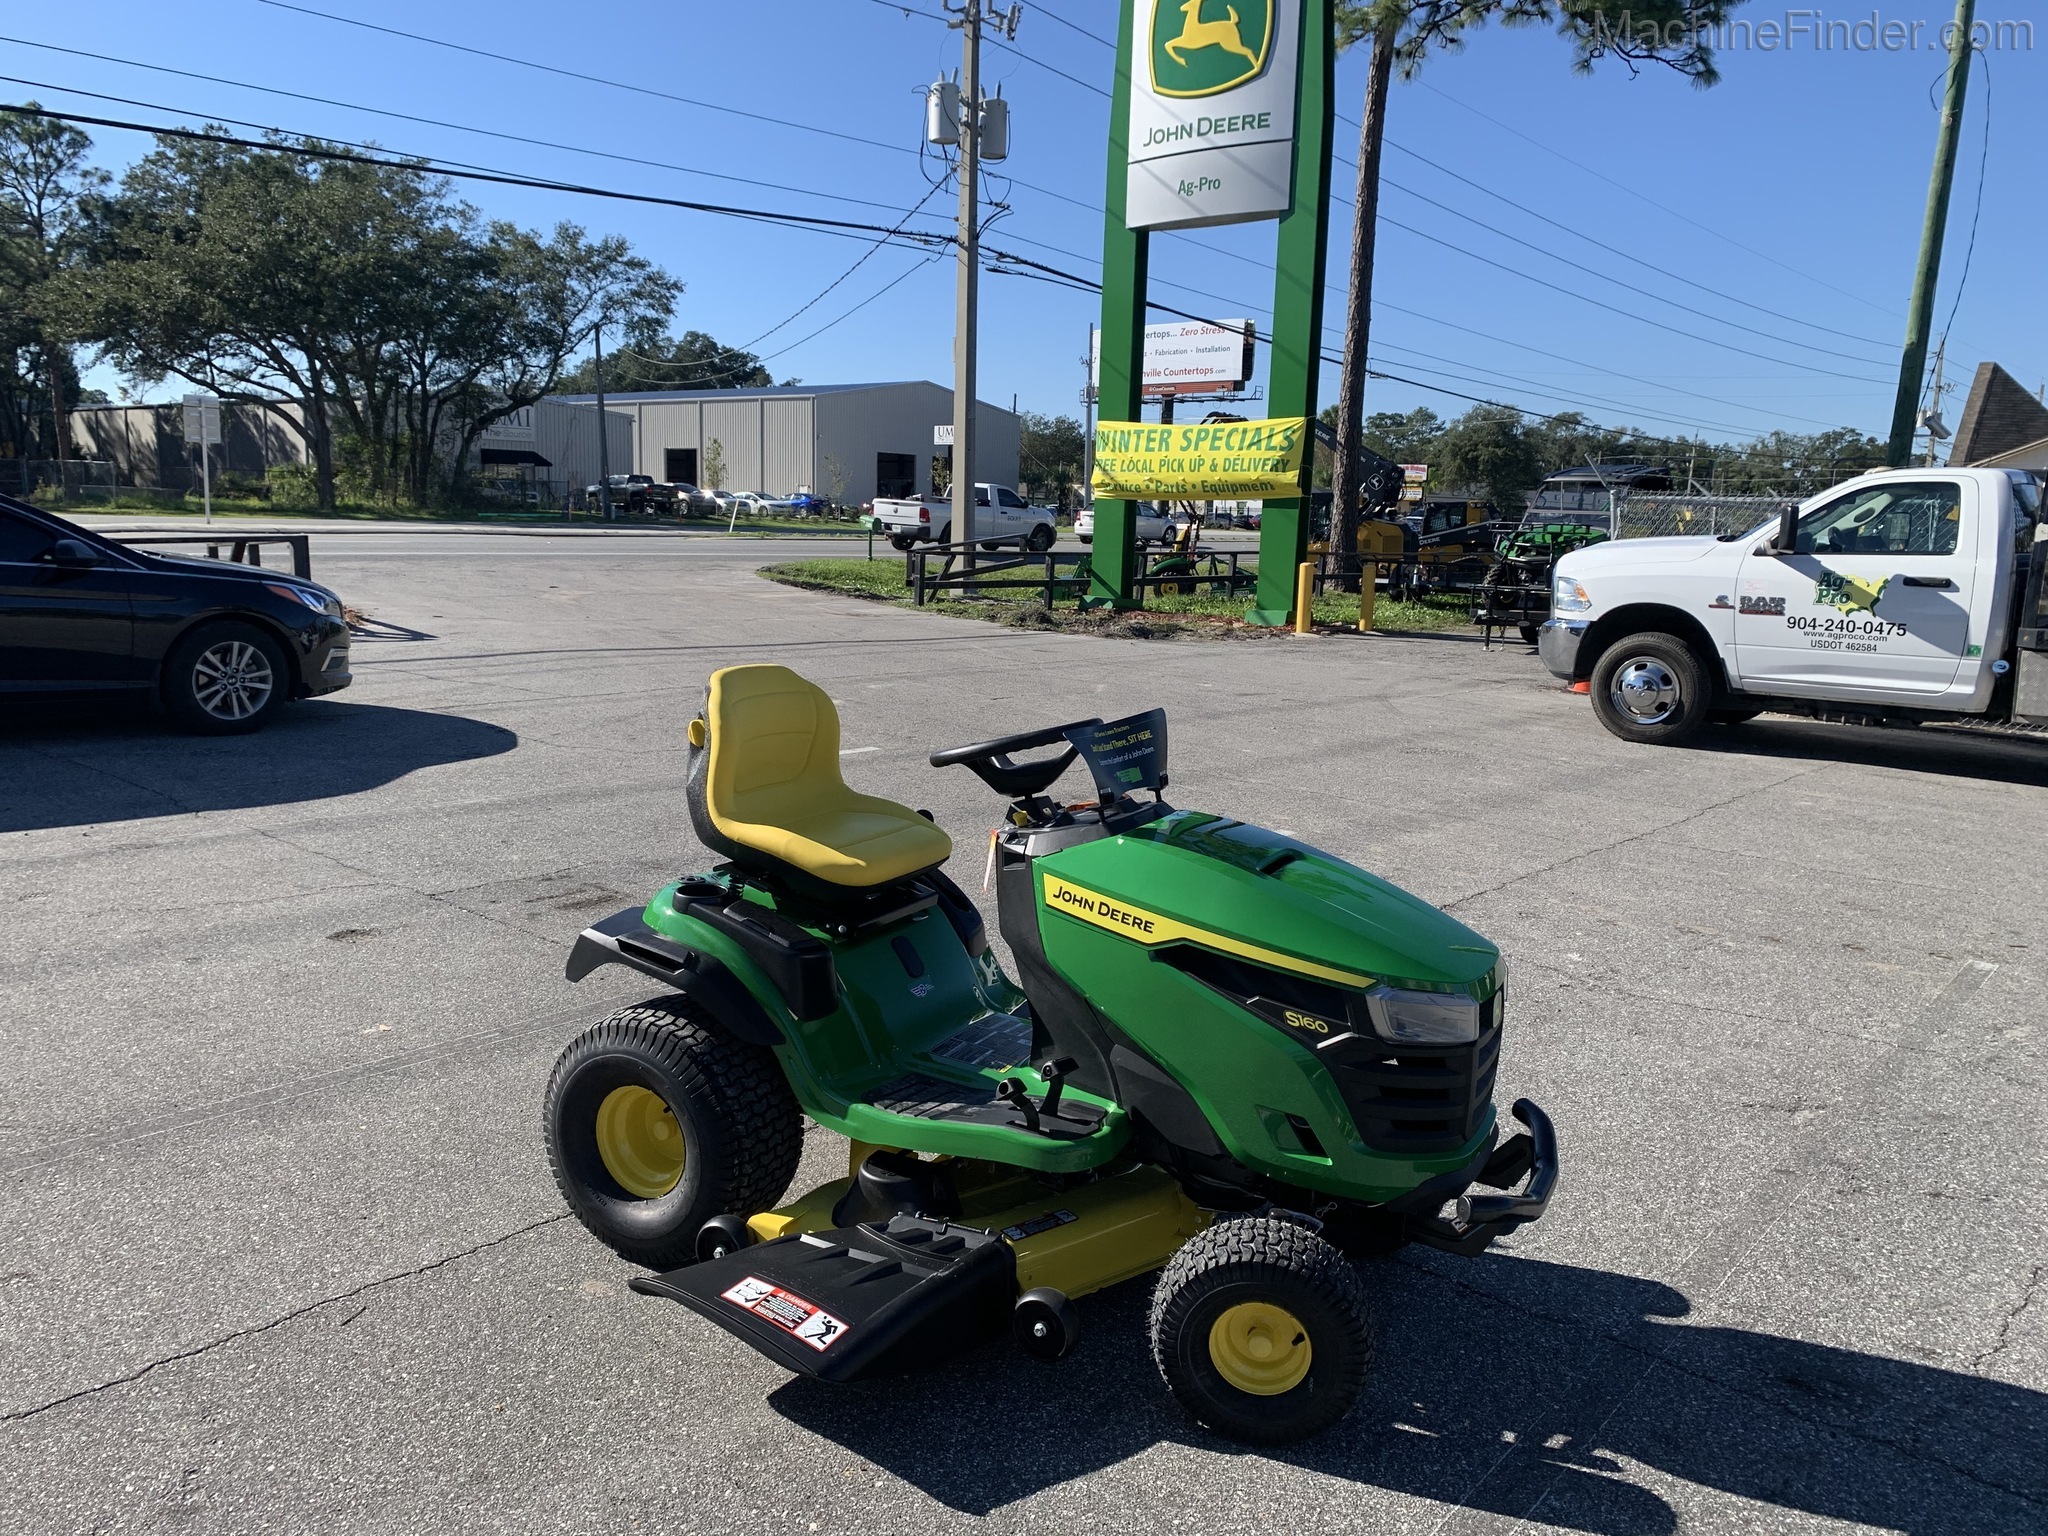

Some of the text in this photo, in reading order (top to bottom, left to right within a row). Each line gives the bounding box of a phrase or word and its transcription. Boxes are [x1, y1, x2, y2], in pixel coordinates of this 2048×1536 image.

[1143, 112, 1271, 147] JOHN DEERE
[1177, 176, 1221, 196] Ag-Pro
[1145, 326, 1226, 340] ertops... Zero Stress
[1155, 348, 1188, 356] Fabrication
[1195, 345, 1231, 353] Installation
[1143, 368, 1161, 377] nville
[938, 426, 954, 437] UM
[1096, 427, 1295, 453] WINTER SPECIALS
[1097, 457, 1290, 473] REE LOCAL PICK UP & DELIVERY
[1155, 480, 1188, 494] Parts
[1201, 480, 1275, 495] Equipment
[1419, 537, 1440, 545] DEERE
[1817, 571, 1854, 591] Ag-
[1814, 587, 1852, 605] Pro
[1787, 616, 1907, 636] 904-240-0475
[1803, 630, 1888, 641] www.agproco.com
[1810, 640, 1877, 652] USDOT 462584
[1052, 885, 1155, 934] JOHN DEERE
[1284, 1010, 1329, 1034] S160
[785, 1295, 813, 1311] DANGER
